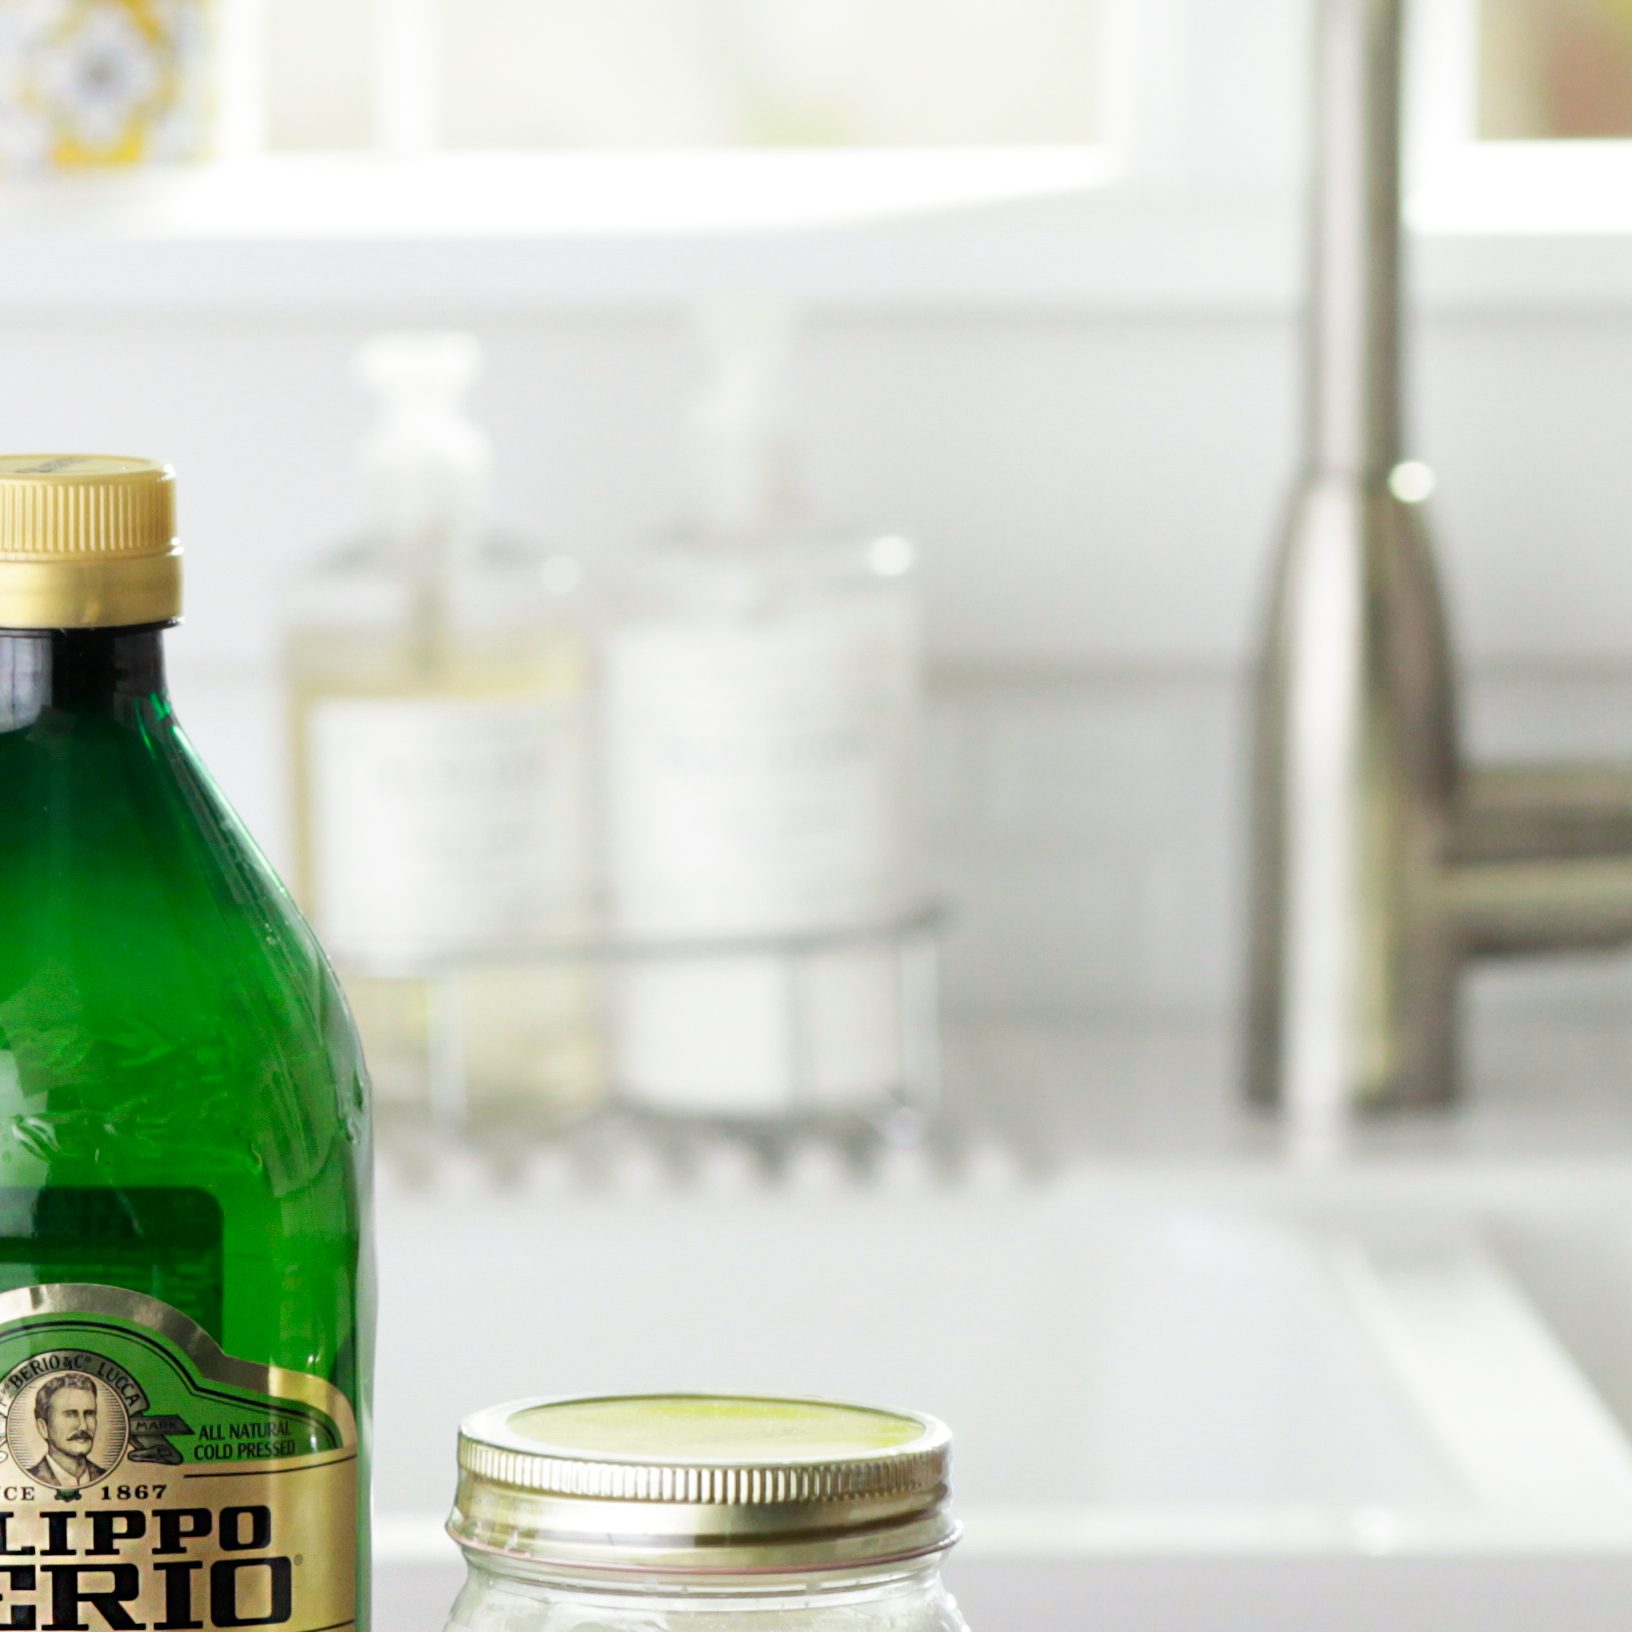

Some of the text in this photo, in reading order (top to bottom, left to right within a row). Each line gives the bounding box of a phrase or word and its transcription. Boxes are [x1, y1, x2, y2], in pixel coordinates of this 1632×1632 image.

[198, 1421, 293, 1441] ALL NATURAL
[194, 1440, 296, 1461] COLD PRESSED
[100, 1484, 168, 1502] 1867
